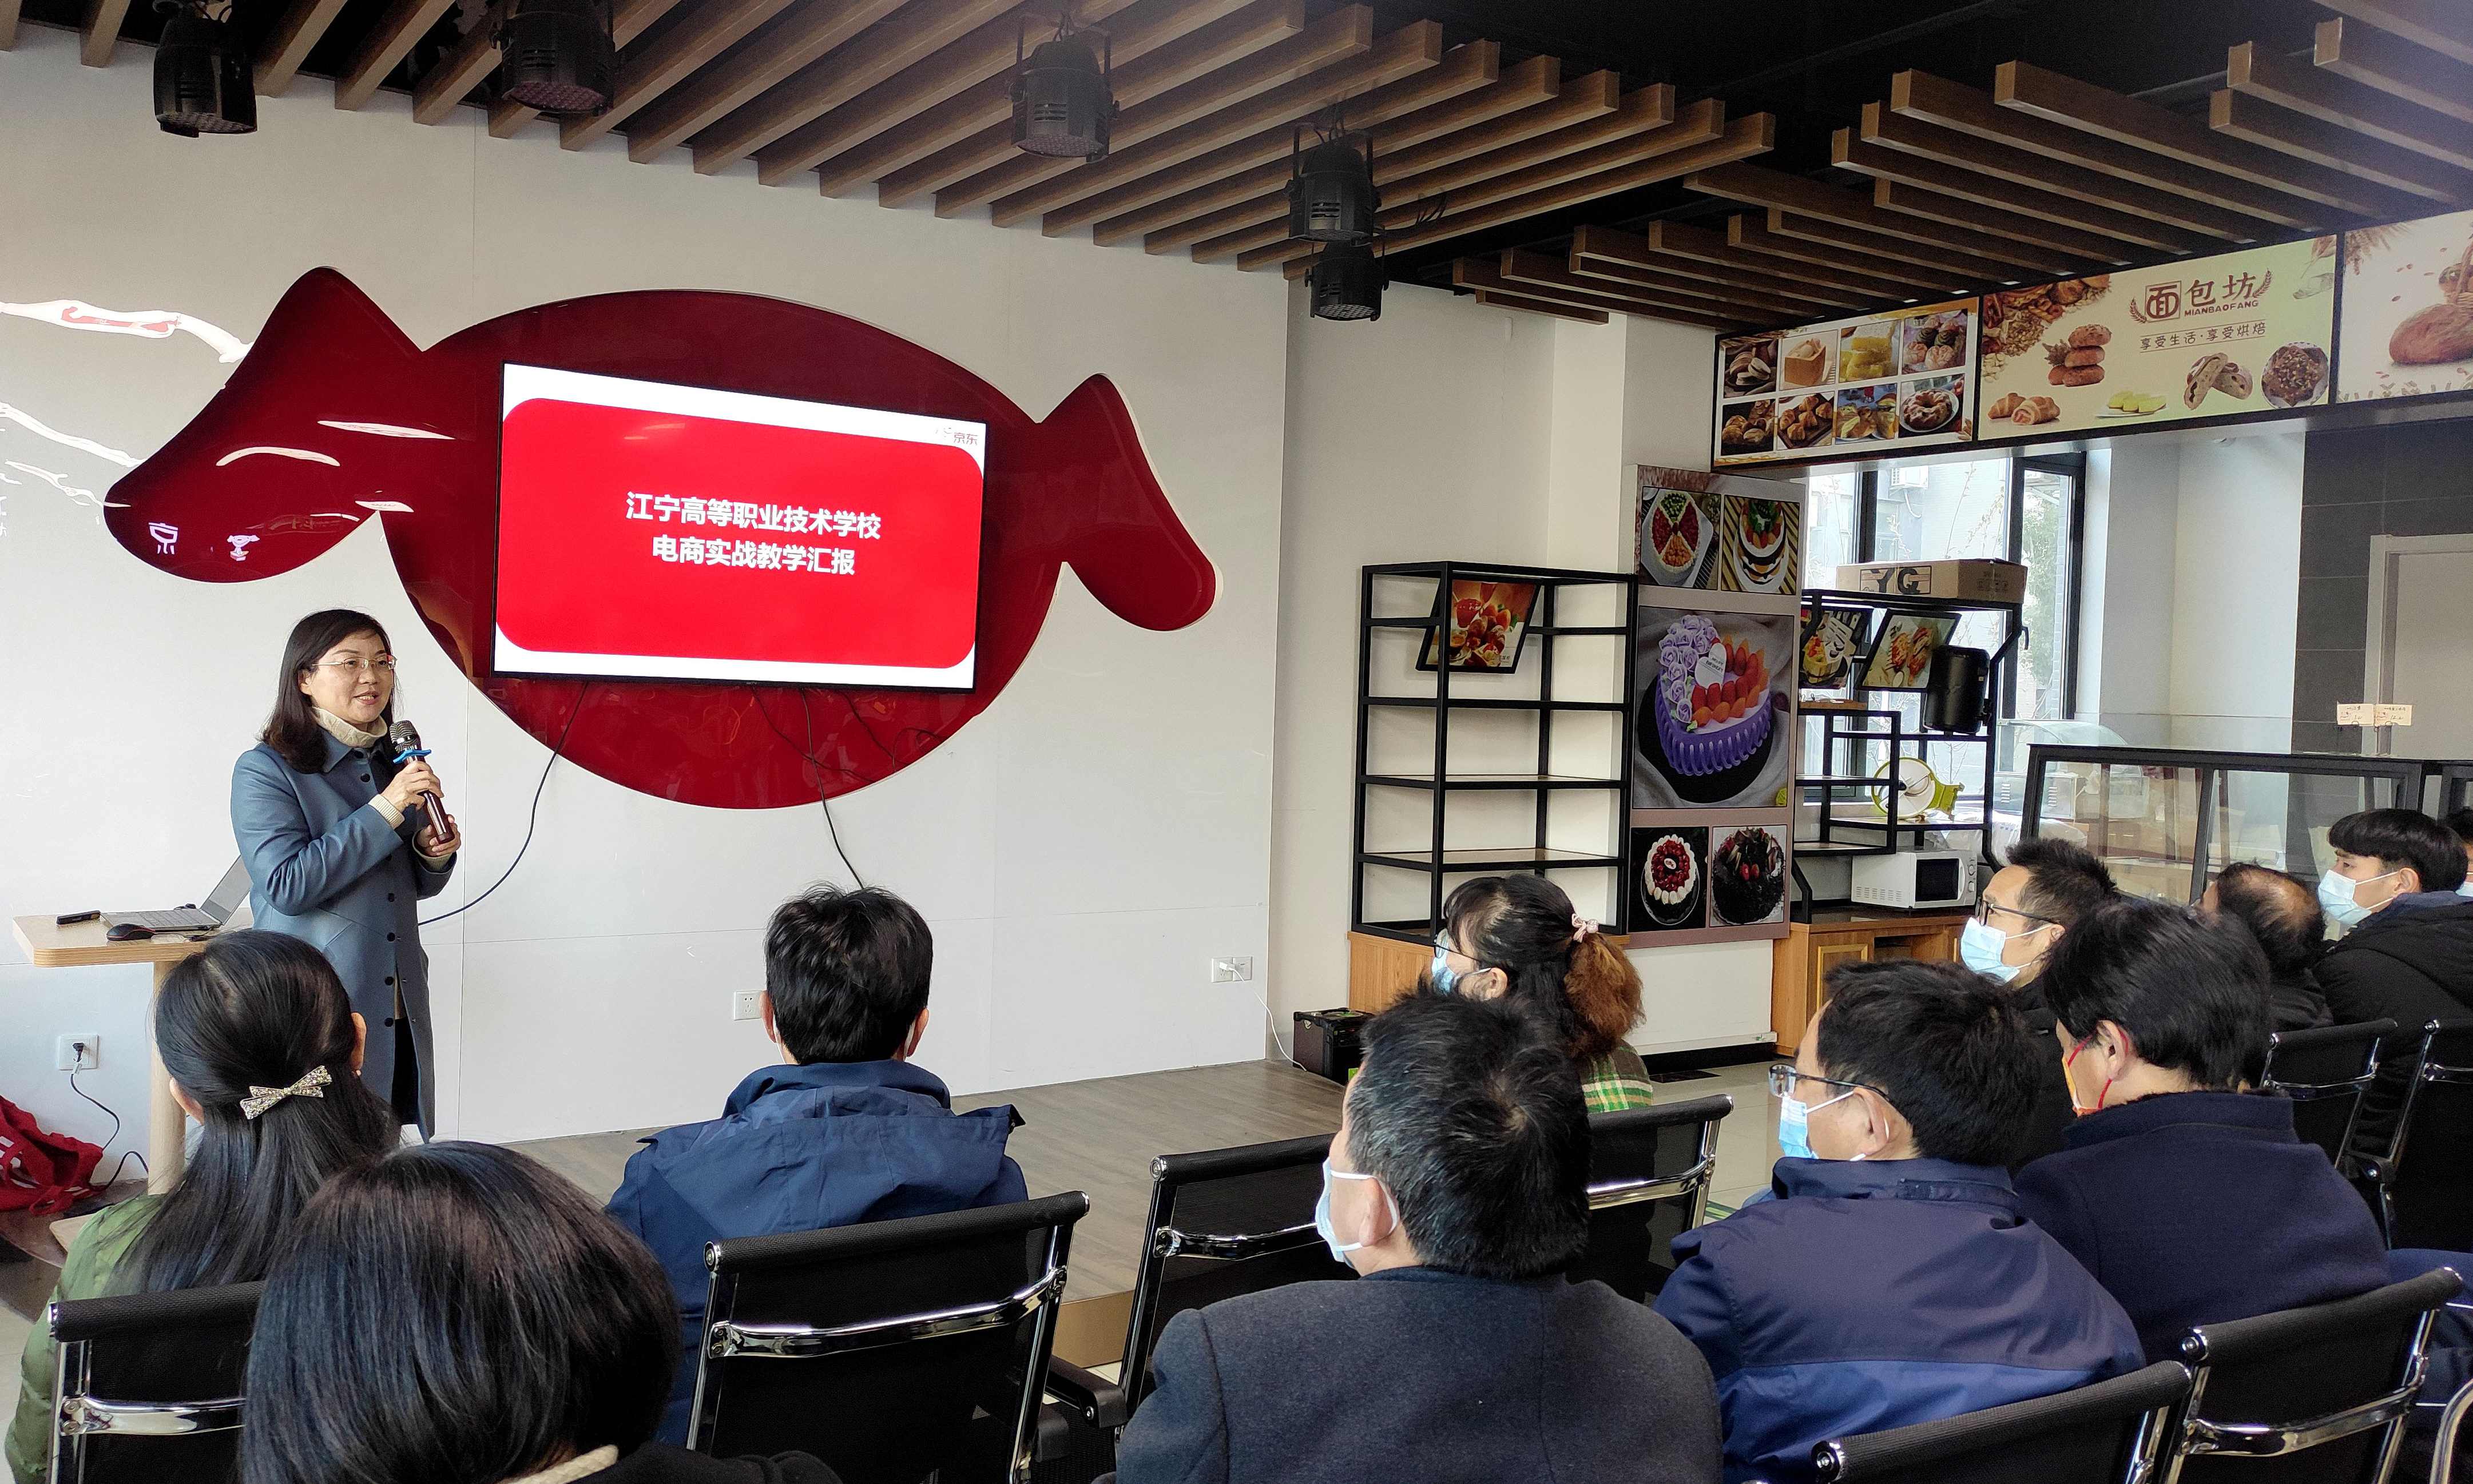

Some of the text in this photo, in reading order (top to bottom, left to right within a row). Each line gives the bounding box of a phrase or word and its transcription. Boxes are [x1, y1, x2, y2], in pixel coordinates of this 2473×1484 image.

[2146, 272, 2256, 320] 面包坊
[2184, 301, 2259, 316] MIANBAOFANG
[954, 432, 978, 445] 京东
[626, 491, 881, 539] 江宁高等职业技术学校
[653, 534, 855, 575] 电商实战教学汇报
